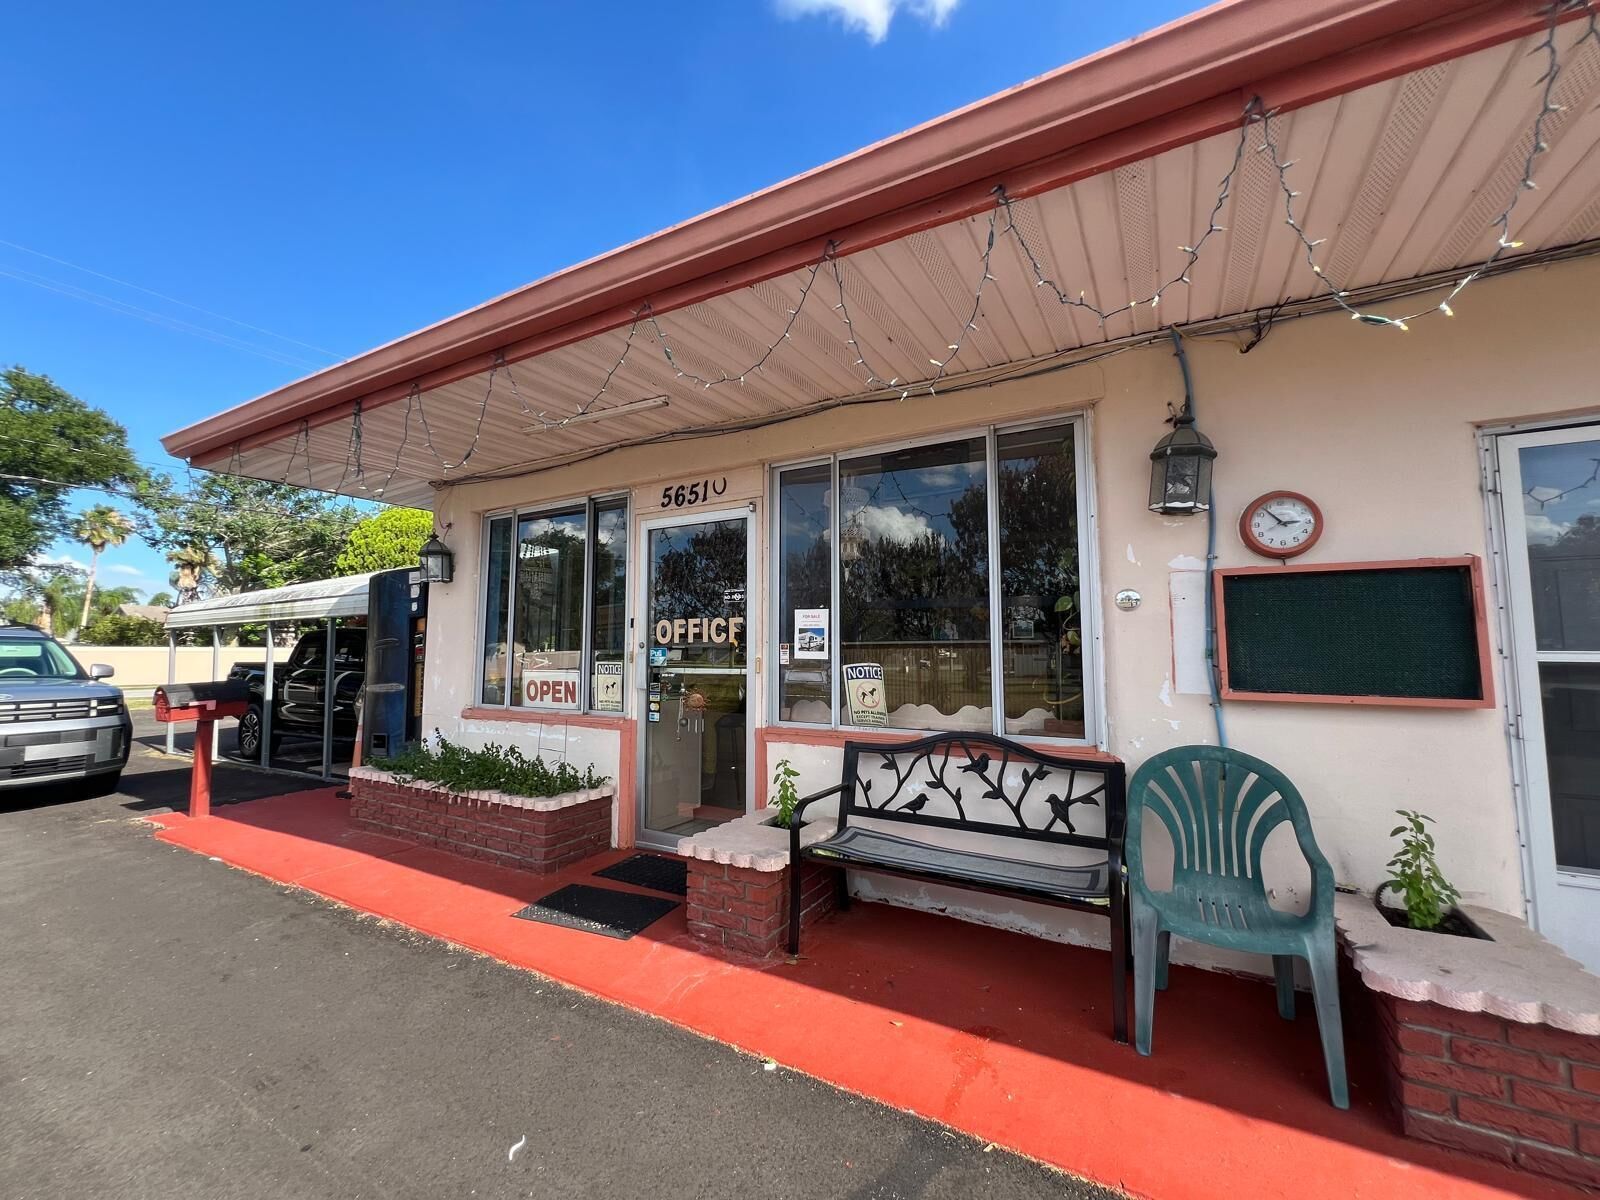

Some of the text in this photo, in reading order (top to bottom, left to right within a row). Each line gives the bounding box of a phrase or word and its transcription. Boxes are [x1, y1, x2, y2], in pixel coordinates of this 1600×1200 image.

[598, 664, 621, 674] NOTICE
[847, 666, 882, 679] NOTICE
[526, 679, 577, 703] OPEN
